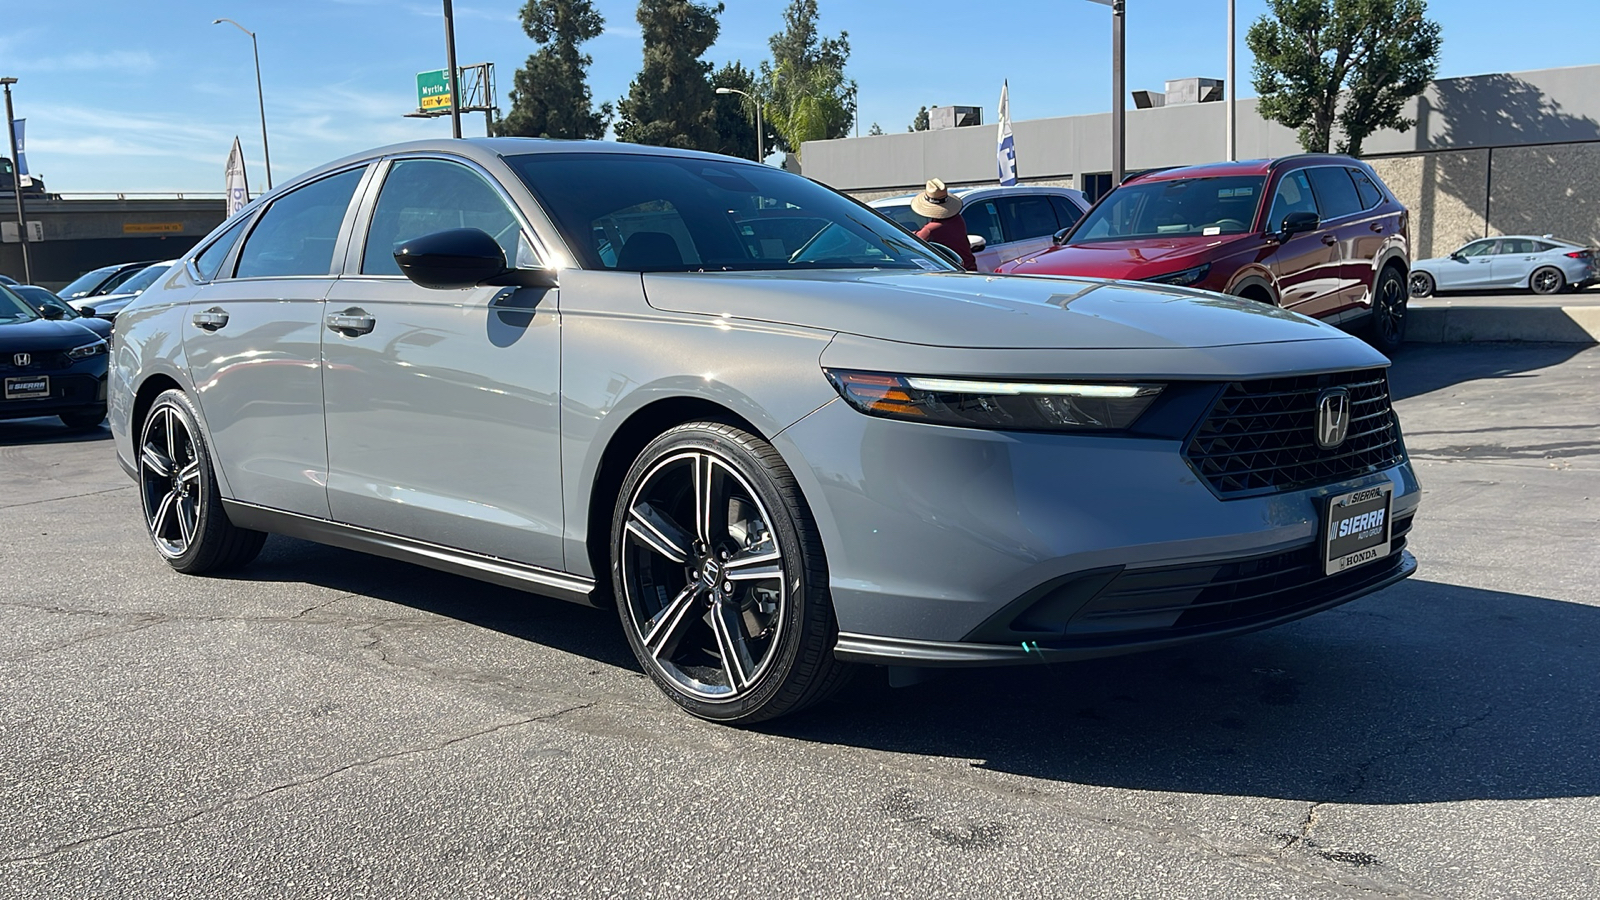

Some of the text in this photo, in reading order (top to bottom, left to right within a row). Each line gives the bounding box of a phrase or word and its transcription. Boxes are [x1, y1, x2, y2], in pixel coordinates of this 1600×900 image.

[422, 84, 443, 95] Myrtle
[423, 99, 433, 107] EXIT
[14, 381, 45, 390] SIERRA
[1351, 486, 1381, 503] SIERRA
[1338, 508, 1385, 537] SIERRA
[1358, 526, 1383, 540] AUTO GROUP
[1346, 549, 1377, 566] HONDA
